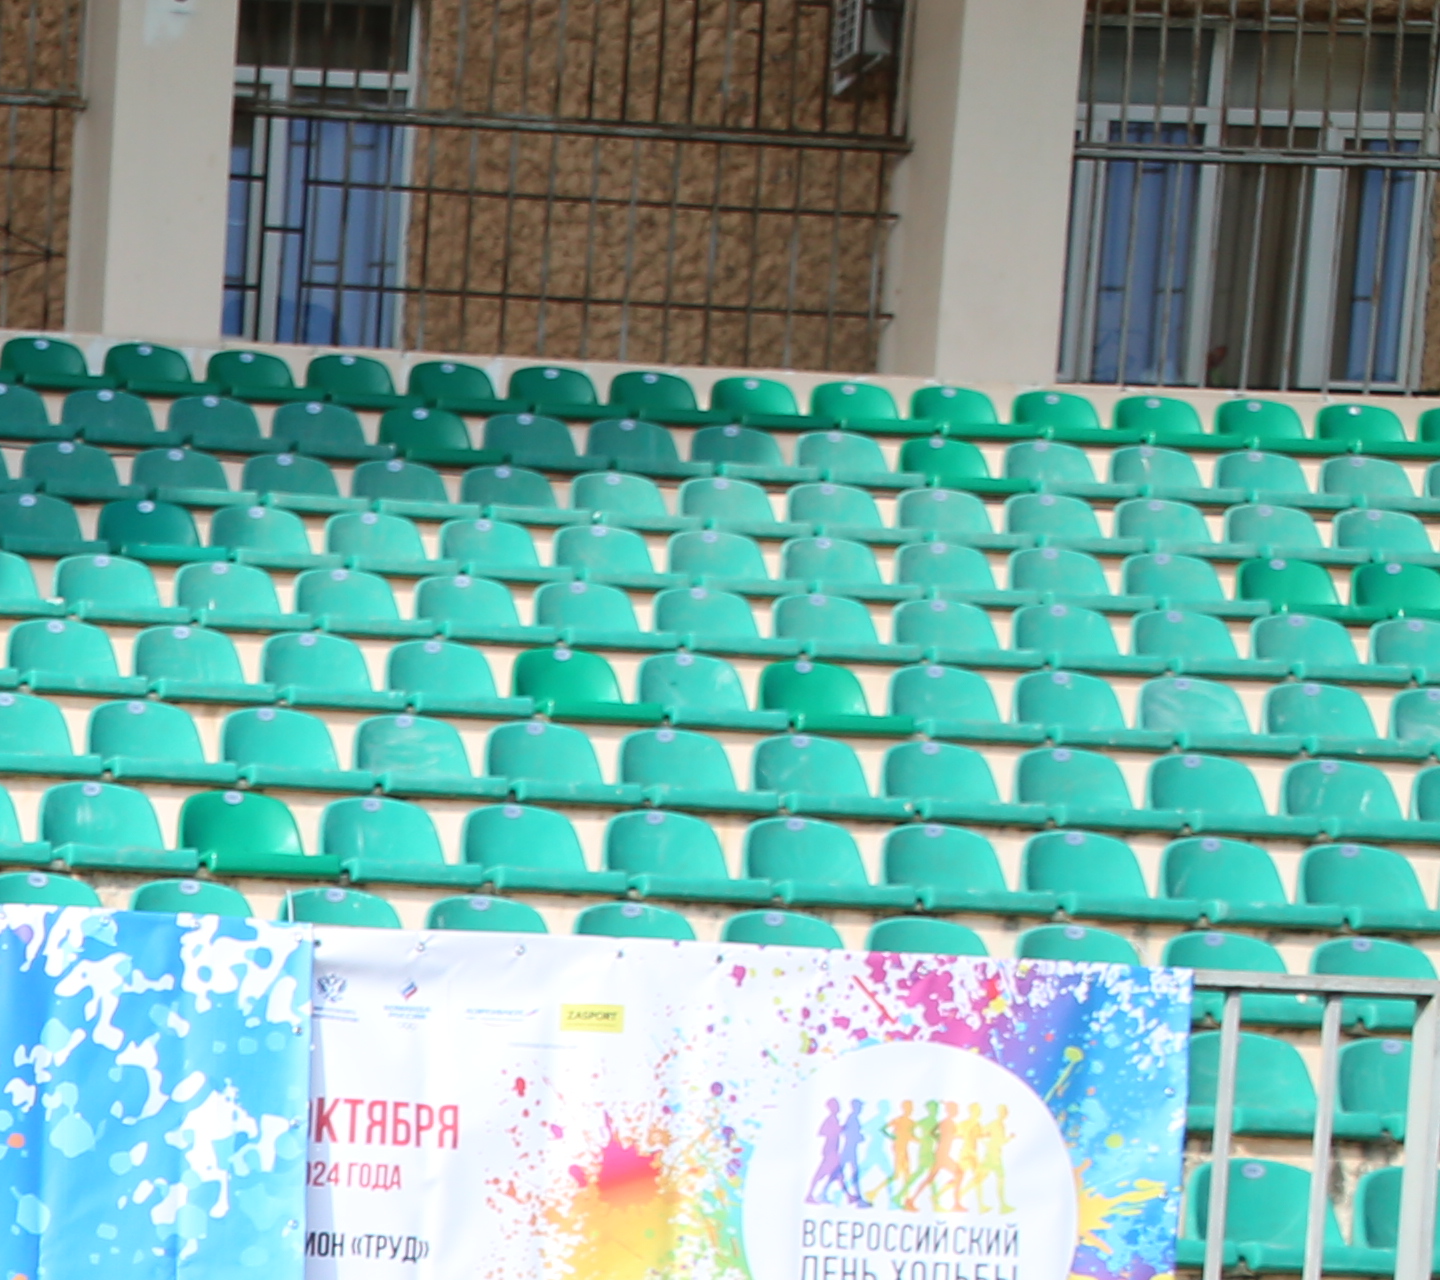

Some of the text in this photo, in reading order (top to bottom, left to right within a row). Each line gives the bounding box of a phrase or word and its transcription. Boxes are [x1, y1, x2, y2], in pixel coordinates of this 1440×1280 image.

[308, 1097, 459, 1149] КТЯБРЯ
[347, 1163, 402, 1192] ГОДА
[802, 1219, 1019, 1257] ВСЕРОССИЙСКИЙ
